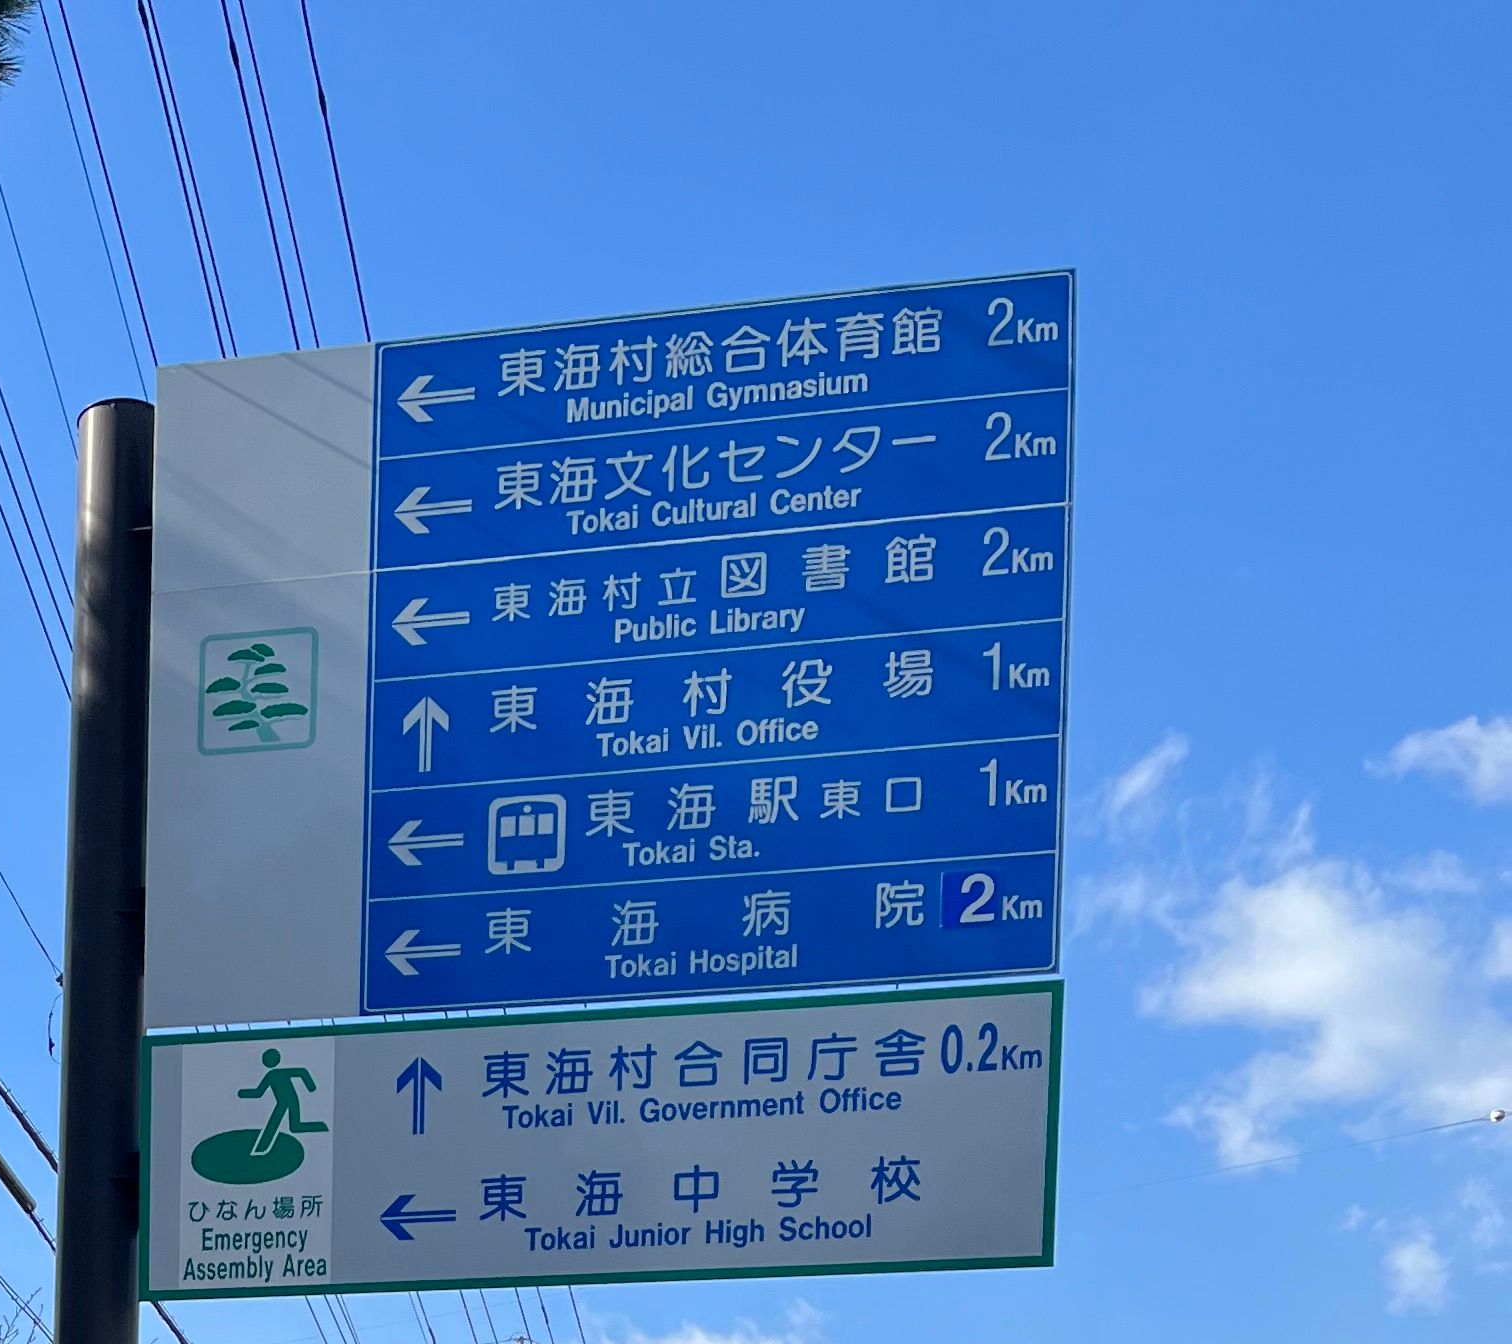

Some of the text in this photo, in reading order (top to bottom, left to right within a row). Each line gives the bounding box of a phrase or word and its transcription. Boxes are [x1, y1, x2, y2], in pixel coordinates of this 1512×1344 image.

[497, 306, 943, 397] 東海村総合体育館
[566, 371, 868, 424] Municipal Gymnasium
[494, 425, 937, 510] 東海文化センター
[565, 485, 862, 535] Tokai Cultural Center
[491, 534, 937, 622] 東海村立図書館
[614, 606, 805, 644] Public Library
[596, 717, 819, 757] Tokai Vil. Office
[586, 776, 922, 837] 東海駅東口
[622, 835, 760, 867] Tokai Sta.
[605, 944, 798, 978] Tokai Hospital
[482, 1028, 926, 1098] 東海村合同庁舎
[502, 1087, 902, 1129] Tokai Vil. Government Office
[188, 1195, 324, 1223] ひなん場所
[201, 1227, 308, 1254] Emergency
[524, 1213, 872, 1251] Tokai Junior High School
[183, 1253, 327, 1283] Assembly Area
